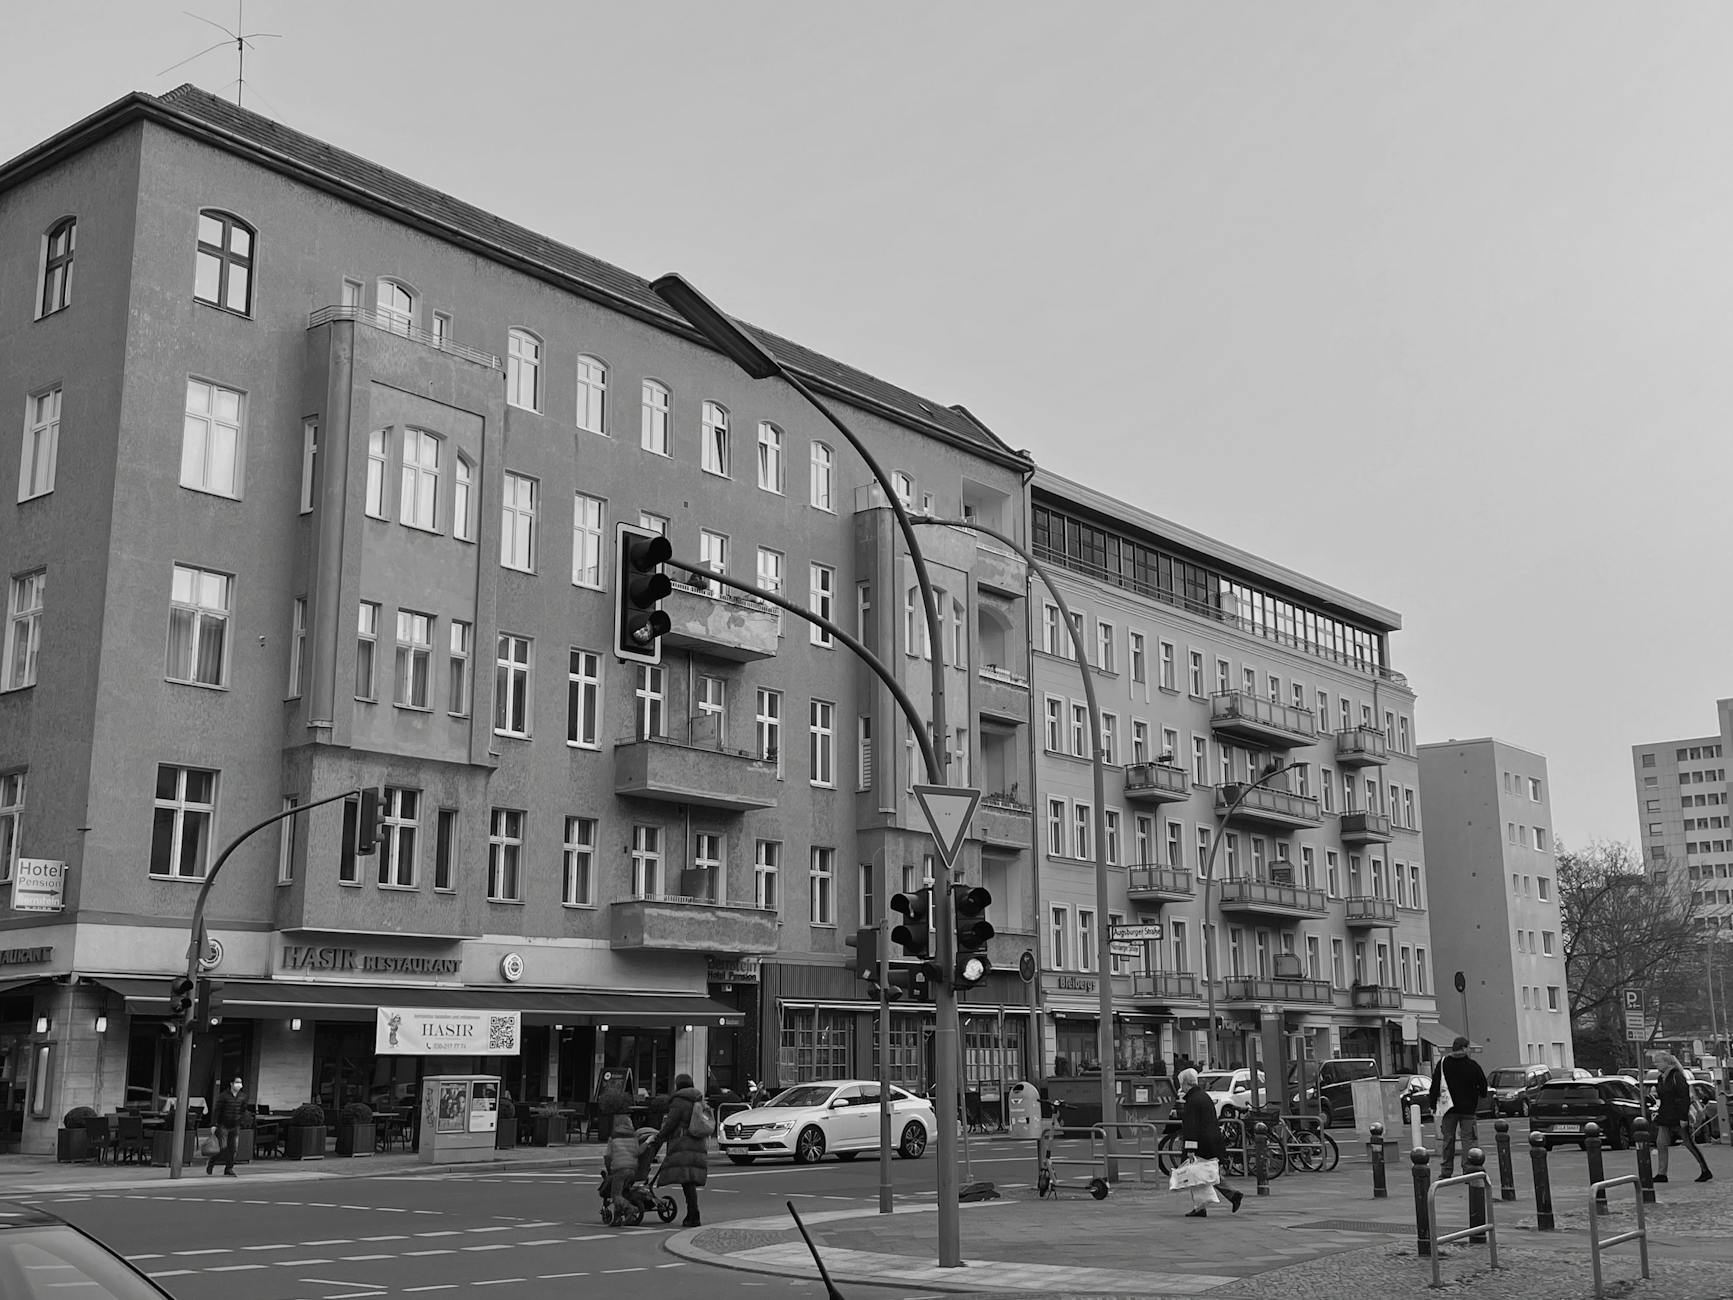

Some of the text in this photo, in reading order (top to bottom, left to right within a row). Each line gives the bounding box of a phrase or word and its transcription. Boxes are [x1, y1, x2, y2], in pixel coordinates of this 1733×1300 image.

[20, 861, 63, 877] Hotel
[18, 876, 61, 888] Pension
[282, 946, 463, 974] HASIR RESTAURANT
[707, 970, 757, 982] Hotel Pension
[1626, 992, 1637, 1005] P
[422, 1023, 474, 1038] HASIR
